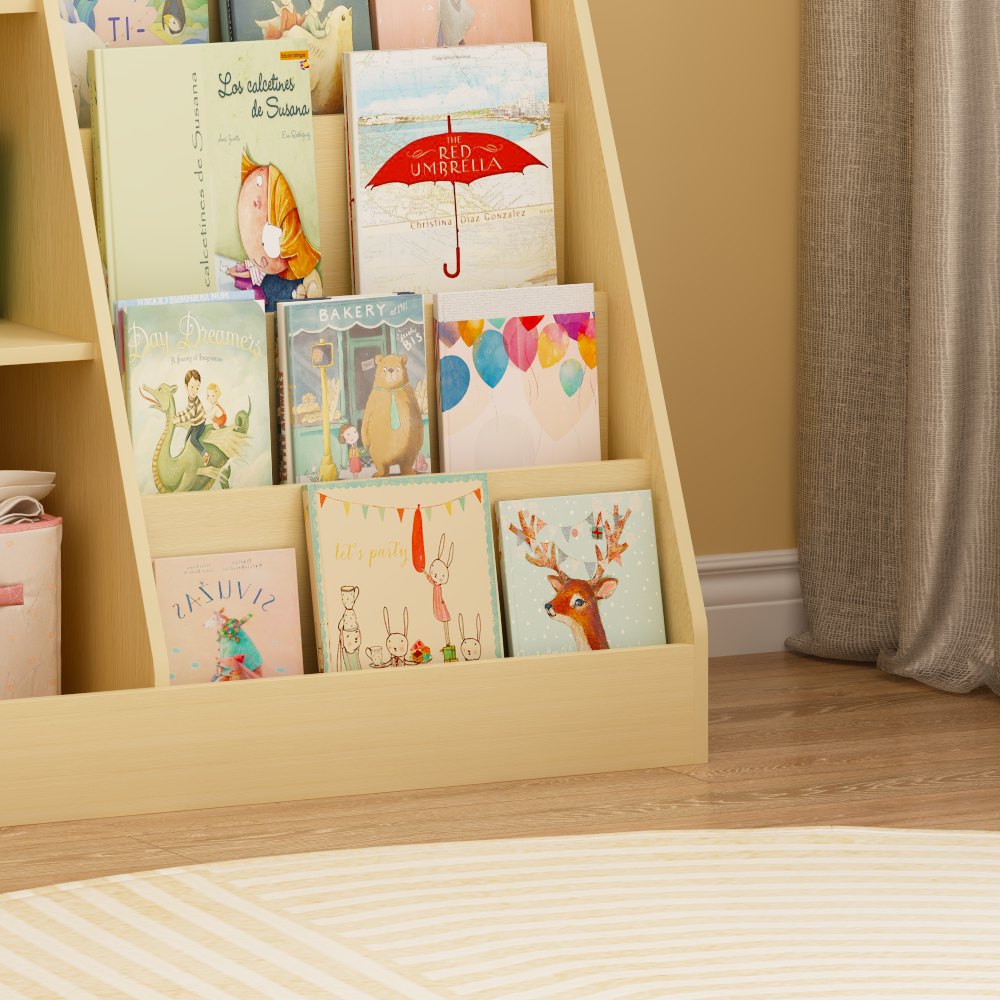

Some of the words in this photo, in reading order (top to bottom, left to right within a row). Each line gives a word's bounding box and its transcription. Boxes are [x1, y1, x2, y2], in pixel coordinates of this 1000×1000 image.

[107, 16, 146, 42] TI-
[218, 71, 244, 98] Los
[246, 72, 296, 94] calcetines
[191, 72, 203, 152] Susana
[251, 99, 264, 119] de
[265, 96, 310, 119] Susana
[439, 145, 472, 160] RED
[446, 136, 462, 144] THE
[193, 158, 204, 183] de
[410, 158, 502, 177] UMBRELLA
[410, 219, 452, 230] Christina
[199, 188, 211, 288] calcetines
[319, 303, 386, 322] BAKERY
[128, 320, 169, 363] Day
[177, 310, 261, 356] Dreamers
[368, 541, 409, 568] party
